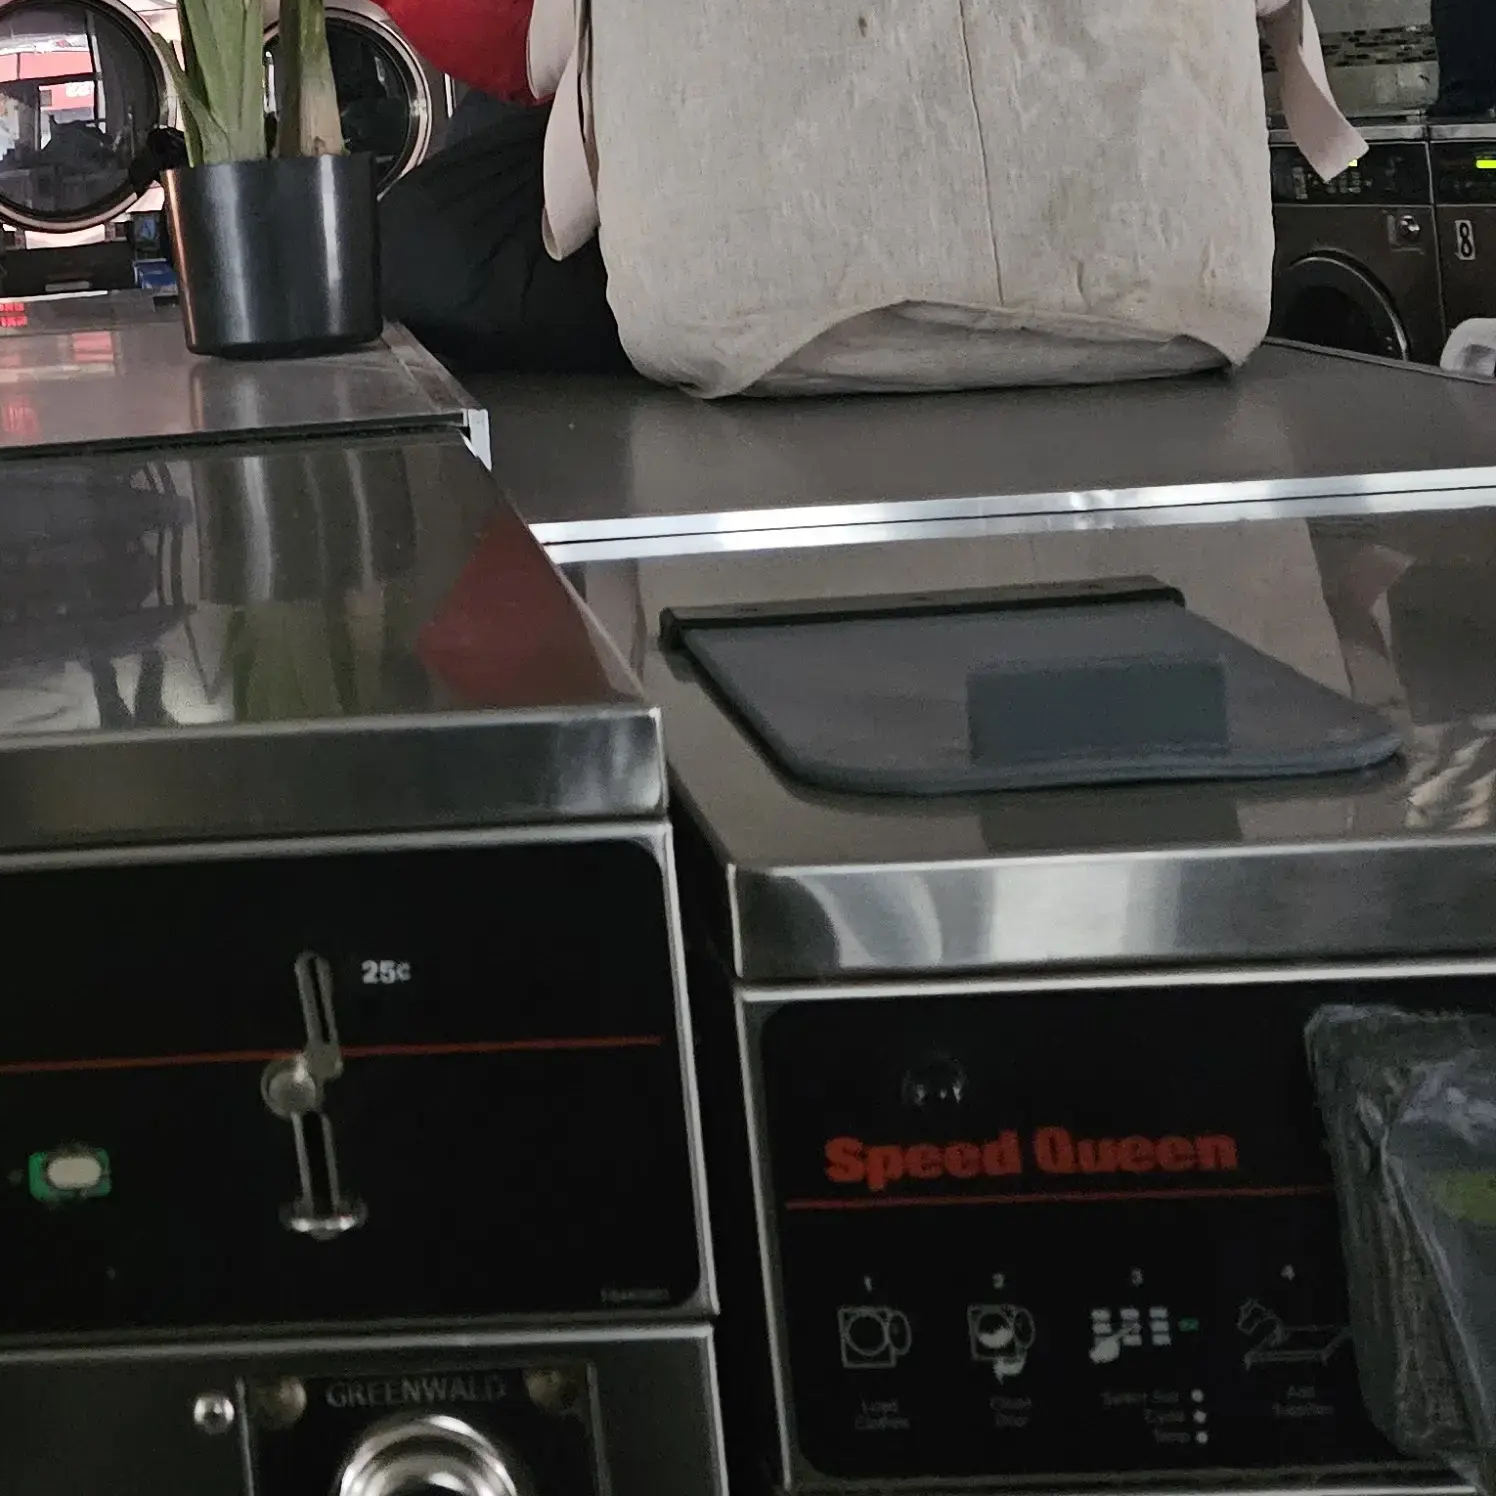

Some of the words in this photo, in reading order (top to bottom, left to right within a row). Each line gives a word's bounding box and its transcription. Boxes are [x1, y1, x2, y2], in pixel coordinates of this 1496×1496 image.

[1459, 222, 1472, 258] 8
[361, 959, 412, 985] 25¢
[823, 1129, 1023, 1191] Speed
[1032, 1126, 1240, 1174] Queen
[325, 1374, 508, 1409] GREENWALD
